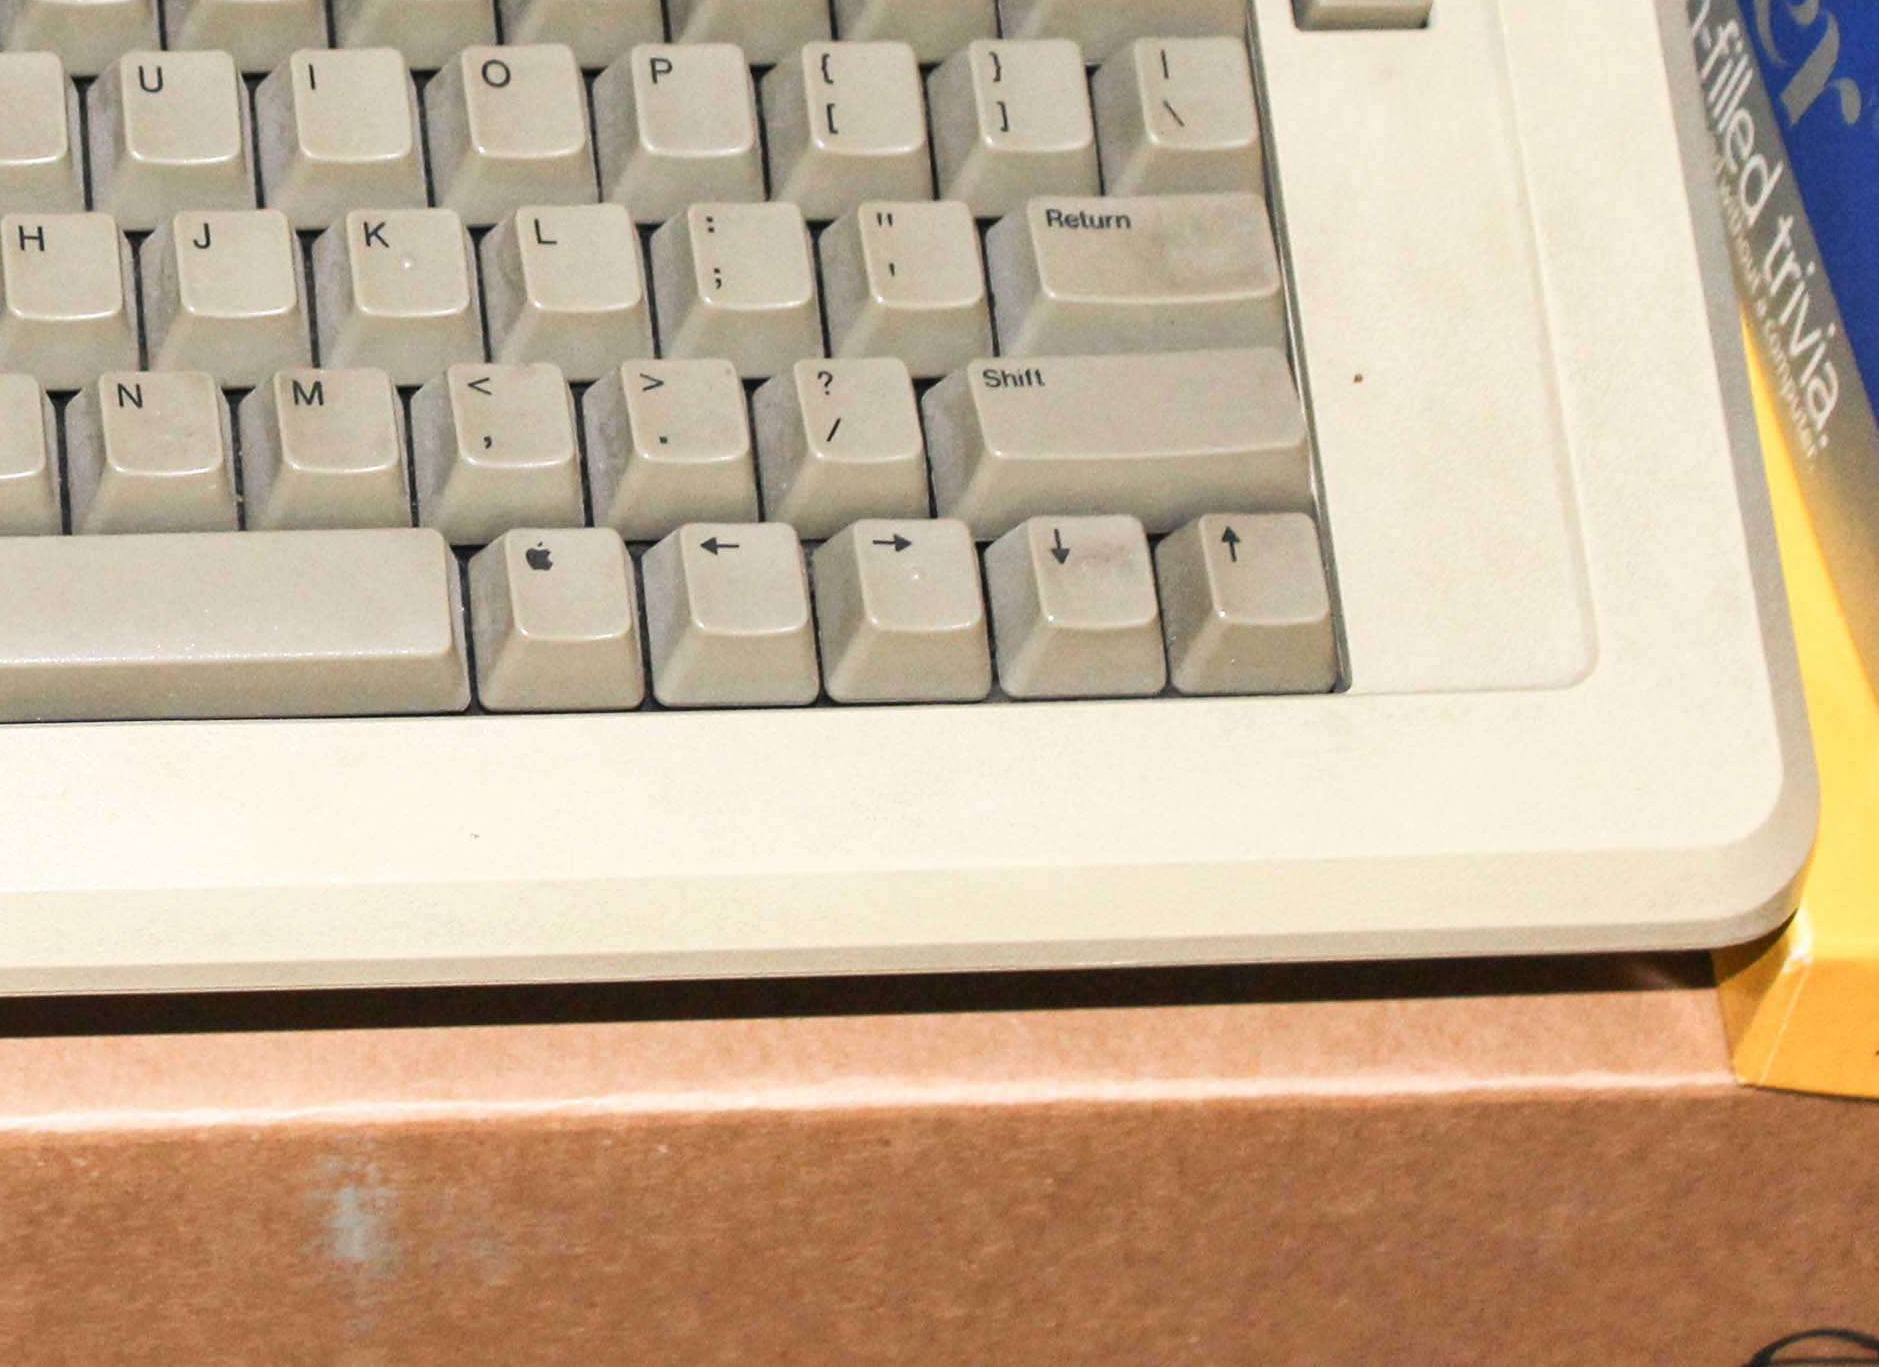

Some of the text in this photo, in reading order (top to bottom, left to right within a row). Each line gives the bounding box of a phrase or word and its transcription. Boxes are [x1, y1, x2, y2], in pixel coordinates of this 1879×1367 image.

[138, 65, 164, 94] U
[481, 59, 512, 89] O
[649, 57, 673, 85] P
[820, 53, 834, 85] {
[989, 51, 1002, 83] }
[826, 103, 839, 135] [
[996, 101, 1010, 133] ]
[533, 218, 558, 245] L
[706, 216, 715, 234] :
[1045, 208, 1132, 230] Return
[18, 225, 45, 252] H
[193, 222, 211, 250] J
[363, 221, 390, 248] K
[713, 267, 722, 289] ;
[1762, 215, 1840, 450] trivia.
[467, 377, 492, 396] <
[639, 373, 665, 392] >
[817, 370, 834, 396] ?
[982, 368, 1045, 388] Shift
[116, 383, 144, 409] N
[292, 379, 325, 406] M
[826, 417, 842, 443] /
